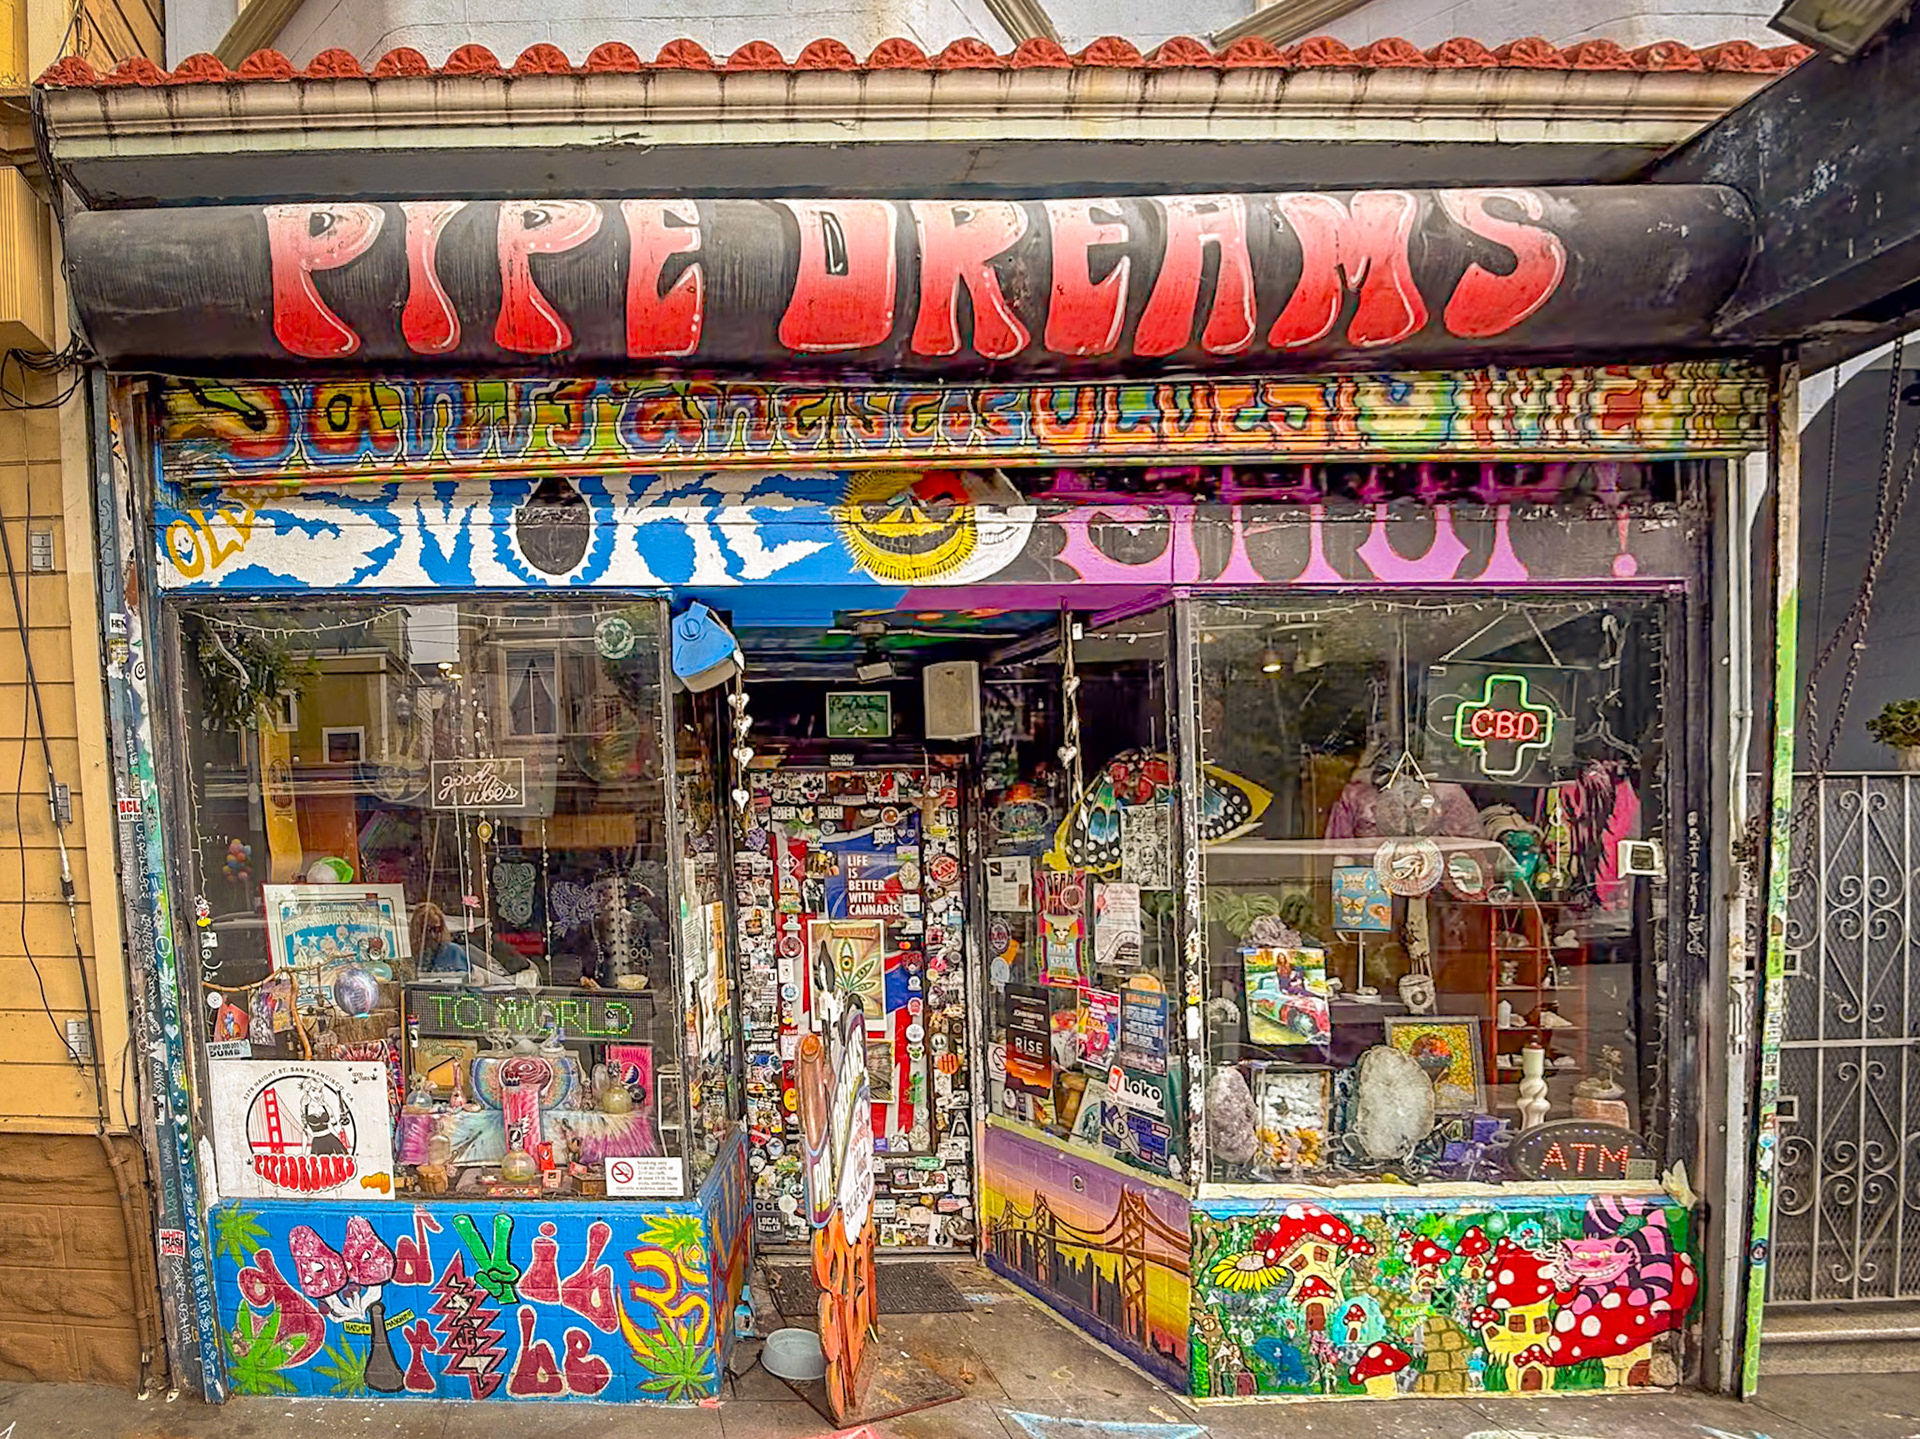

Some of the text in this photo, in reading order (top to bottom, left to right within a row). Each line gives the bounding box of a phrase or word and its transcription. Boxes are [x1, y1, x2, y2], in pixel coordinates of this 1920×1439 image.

[264, 186, 1568, 360] PIPE DREAMS
[1471, 708, 1539, 741] CBD
[438, 762, 494, 802] good
[463, 774, 519, 805] vibes
[772, 806, 796, 819] HOTEL
[818, 806, 843, 819] HOTEL
[847, 854, 869, 866] LIFE
[847, 867, 858, 879] IS
[848, 879, 885, 891] BETTER
[848, 892, 875, 904] WITH
[848, 903, 900, 916] CANNABIS
[428, 995, 634, 1036] TO WORLD
[254, 1070, 277, 1088] HAIGHT
[345, 1092, 355, 1103] CA
[1540, 1141, 1630, 1174] ATM
